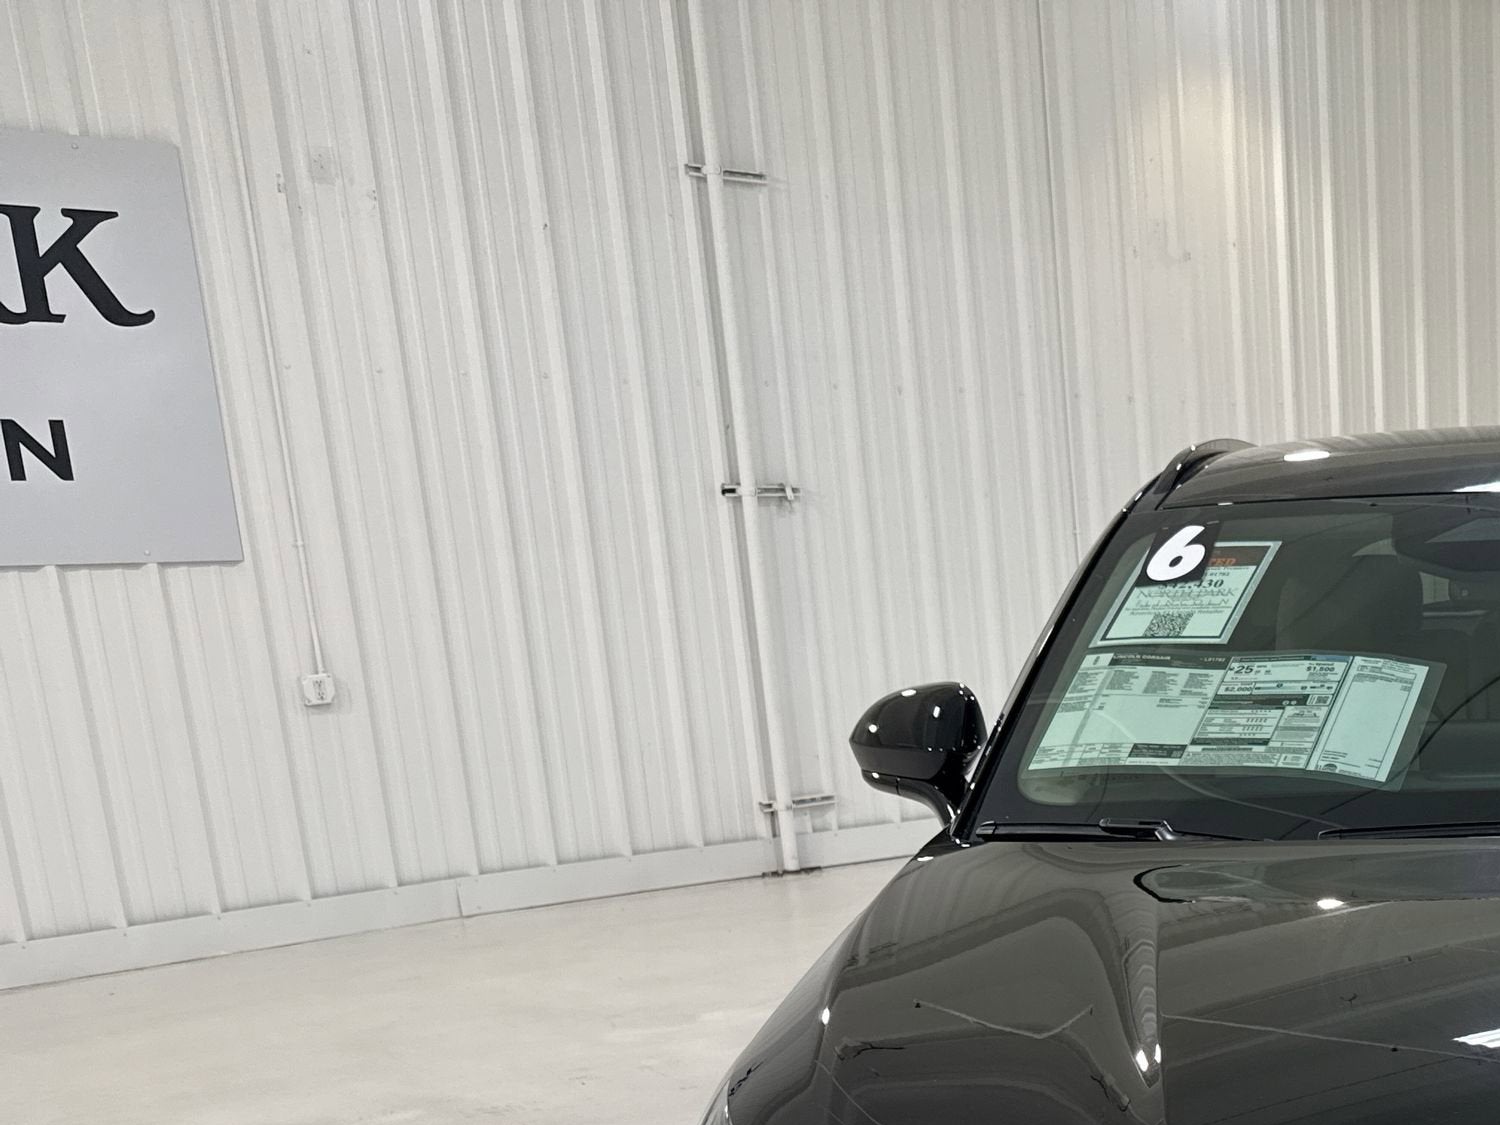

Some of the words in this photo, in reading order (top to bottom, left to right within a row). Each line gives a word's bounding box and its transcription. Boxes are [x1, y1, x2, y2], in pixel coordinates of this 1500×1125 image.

[0, 204, 155, 327] K
[0, 419, 74, 481] N
[1146, 525, 1205, 581] 6
[1234, 665, 1254, 674] 25
